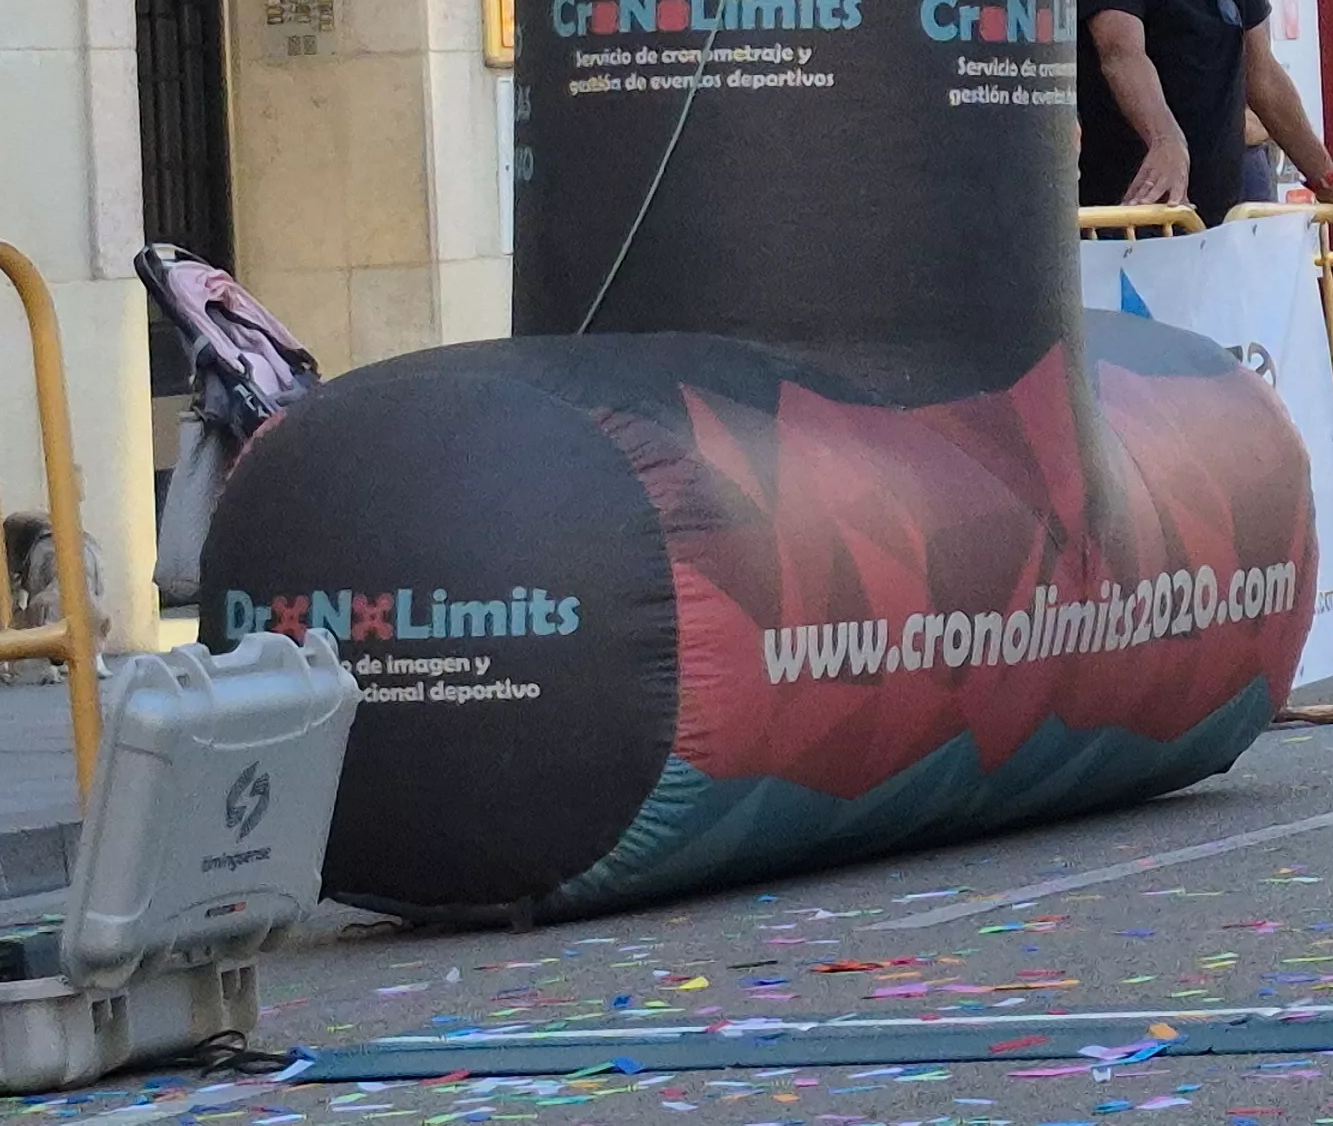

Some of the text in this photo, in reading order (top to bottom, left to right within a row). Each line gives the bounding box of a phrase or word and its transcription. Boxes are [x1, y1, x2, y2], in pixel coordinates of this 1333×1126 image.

[575, 42, 813, 69] Servicio de cronometraje y
[957, 55, 1019, 77] Servicio
[624, 73, 648, 92] de
[650, 72, 722, 91] eventos
[726, 67, 835, 89] deportivos
[949, 84, 1010, 106] gestión
[763, 559, 1298, 686] www.cronolimits2020.com
[356, 653, 383, 675] de
[385, 653, 471, 676] imagen
[475, 653, 492, 677] y
[360, 677, 542, 705] cional deportivo
